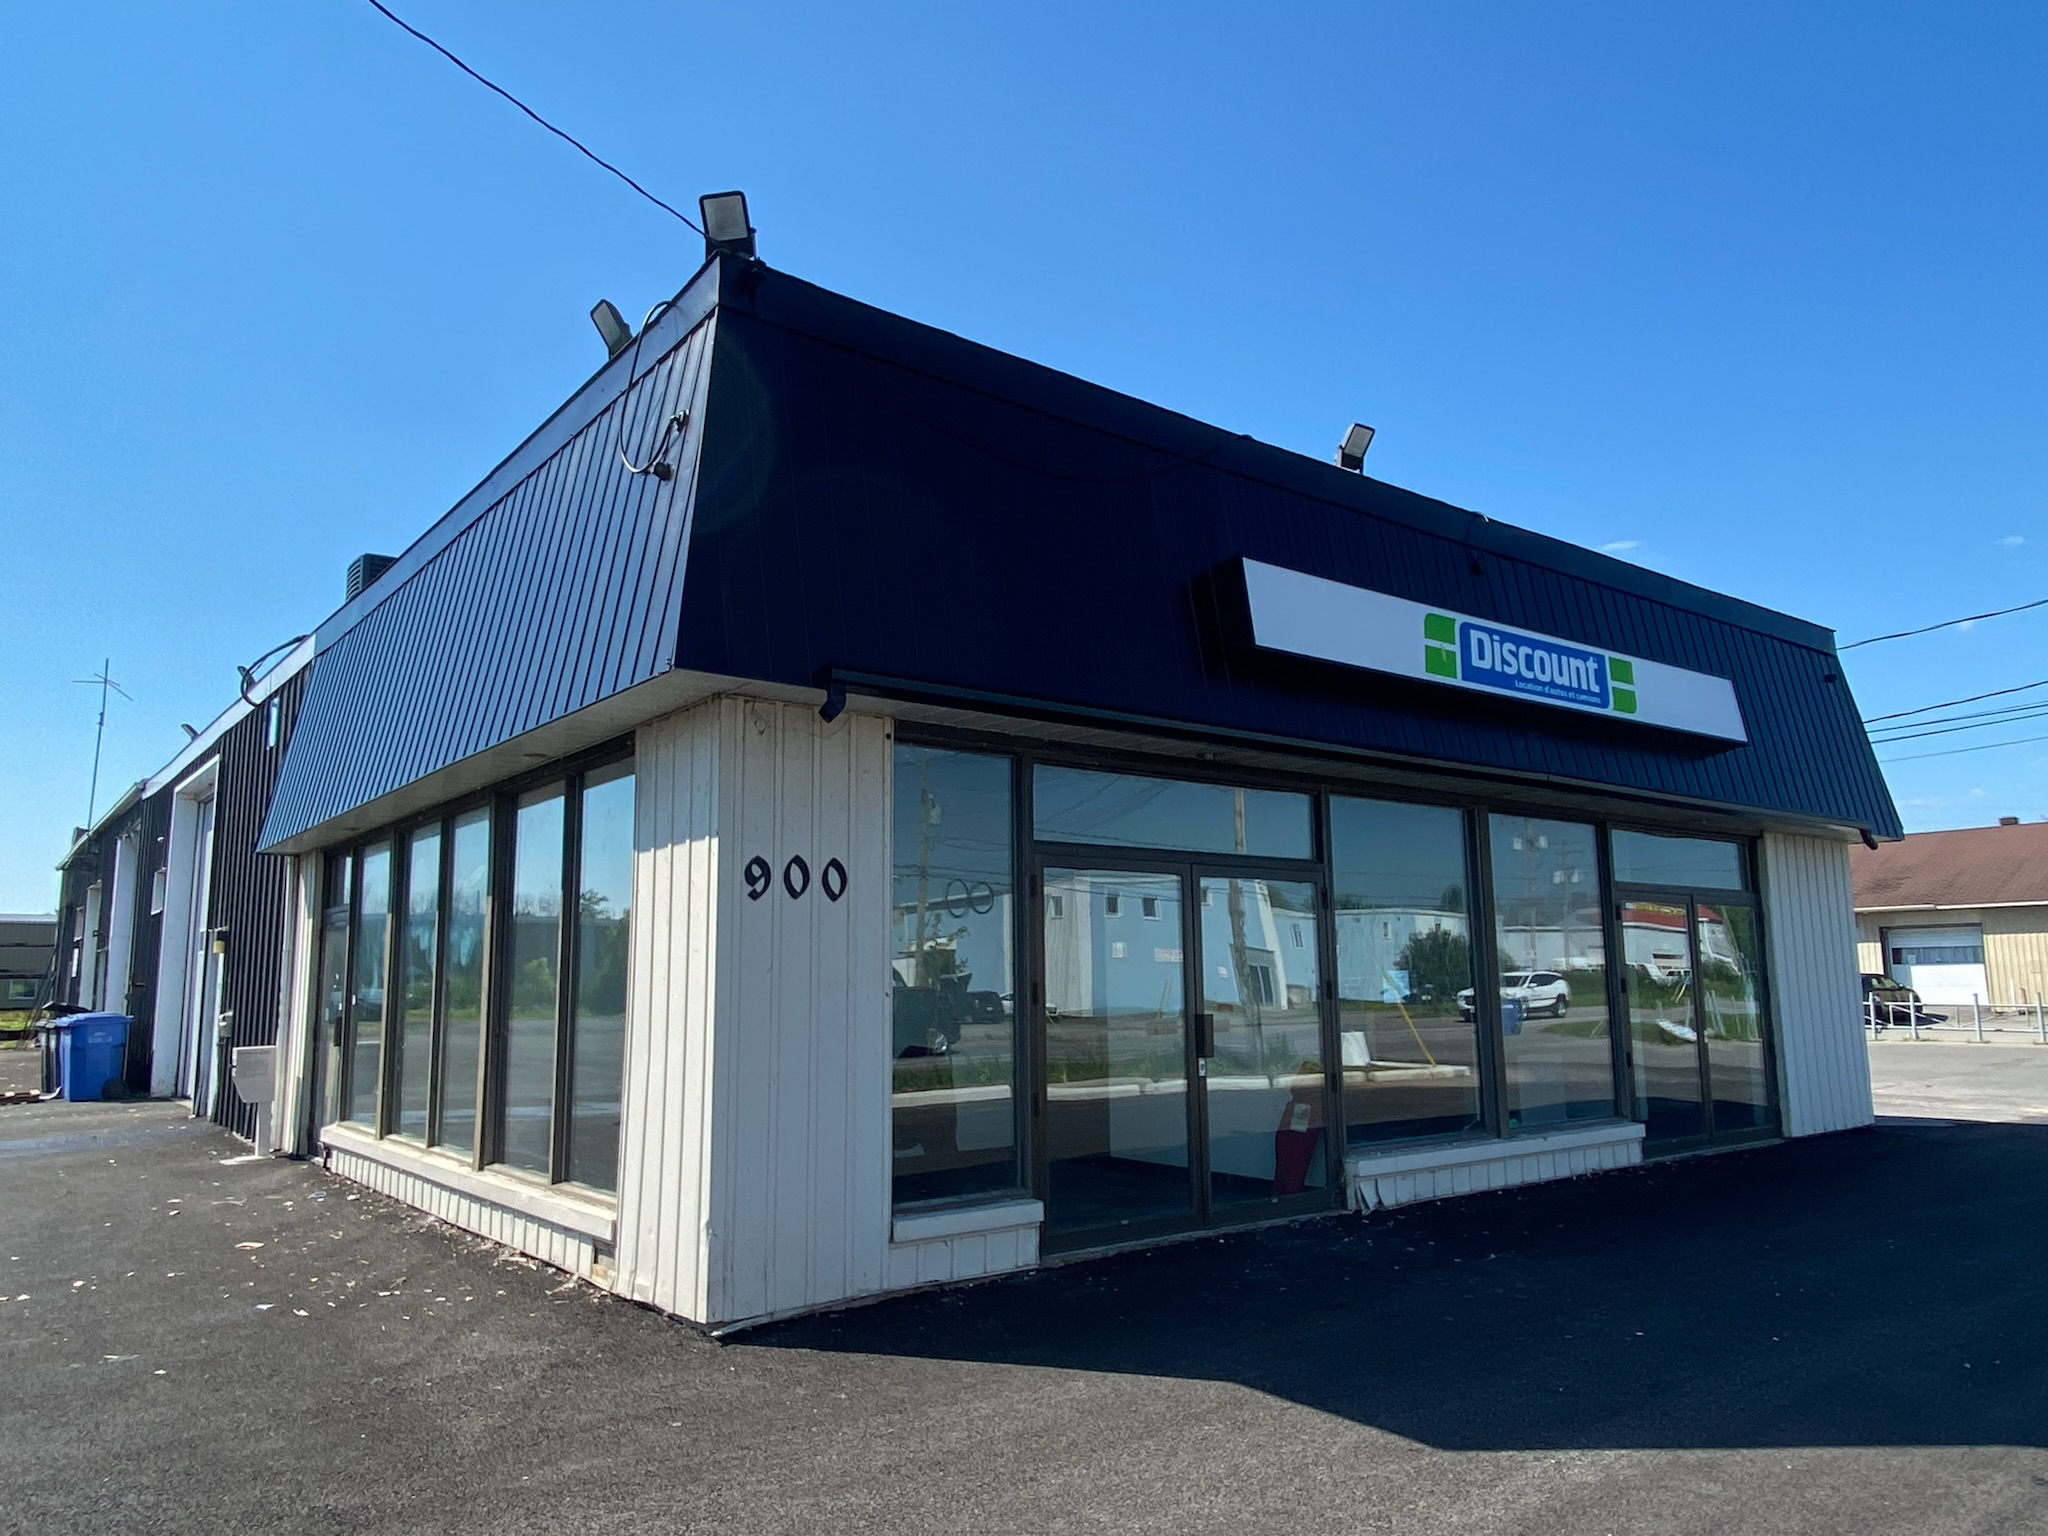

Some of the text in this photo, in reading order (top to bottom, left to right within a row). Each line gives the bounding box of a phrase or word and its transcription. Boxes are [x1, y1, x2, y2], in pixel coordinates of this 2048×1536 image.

[1470, 629, 1600, 693] Discount
[1515, 680, 1544, 692] Location
[744, 854, 848, 902] 900
